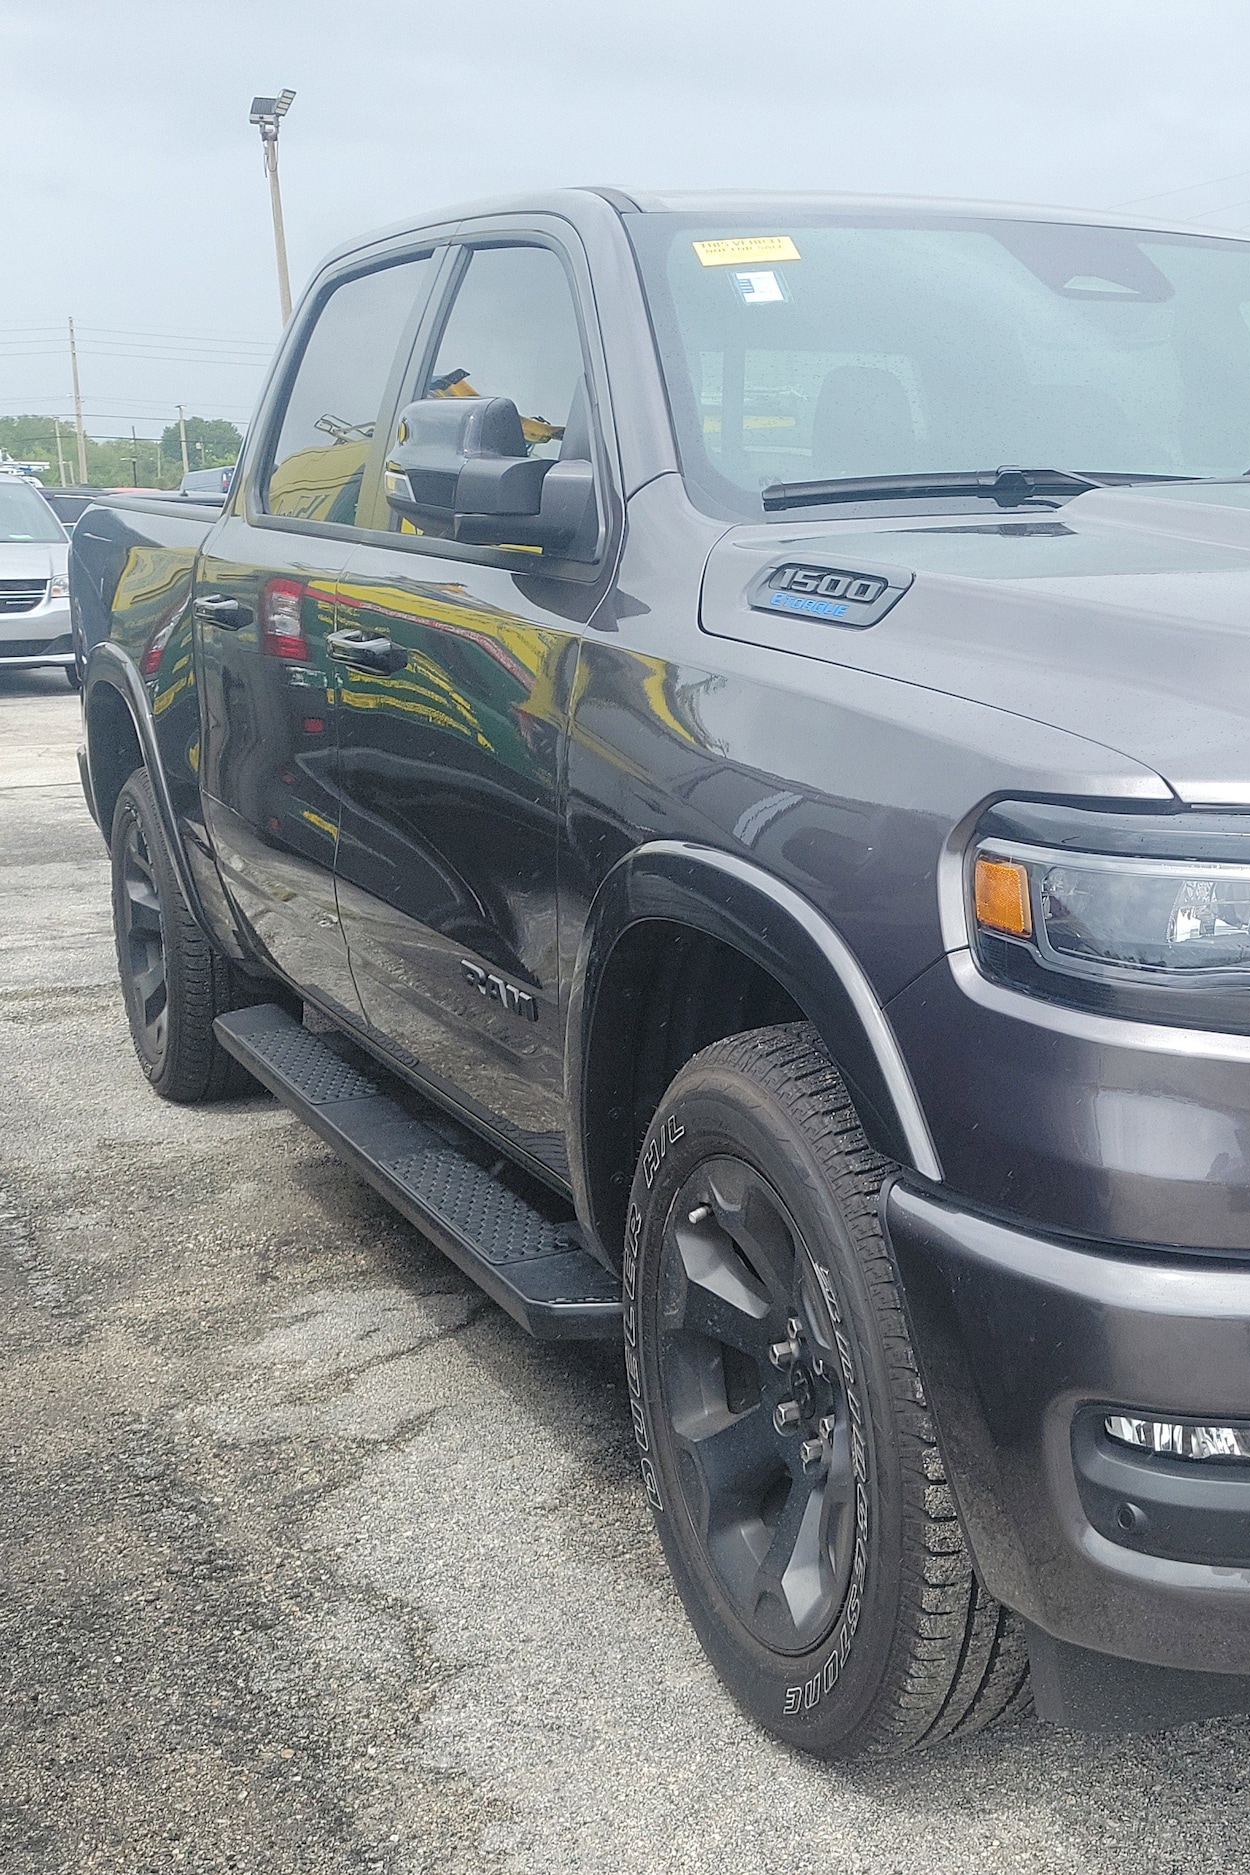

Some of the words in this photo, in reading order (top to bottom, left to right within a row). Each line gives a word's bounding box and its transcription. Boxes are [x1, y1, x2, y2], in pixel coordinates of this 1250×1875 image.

[779, 568, 883, 602] 1500
[460, 959, 538, 1021] RAM
[623, 1202, 664, 1512] DUELER
[783, 1262, 868, 1714] BRIDGESTONE
